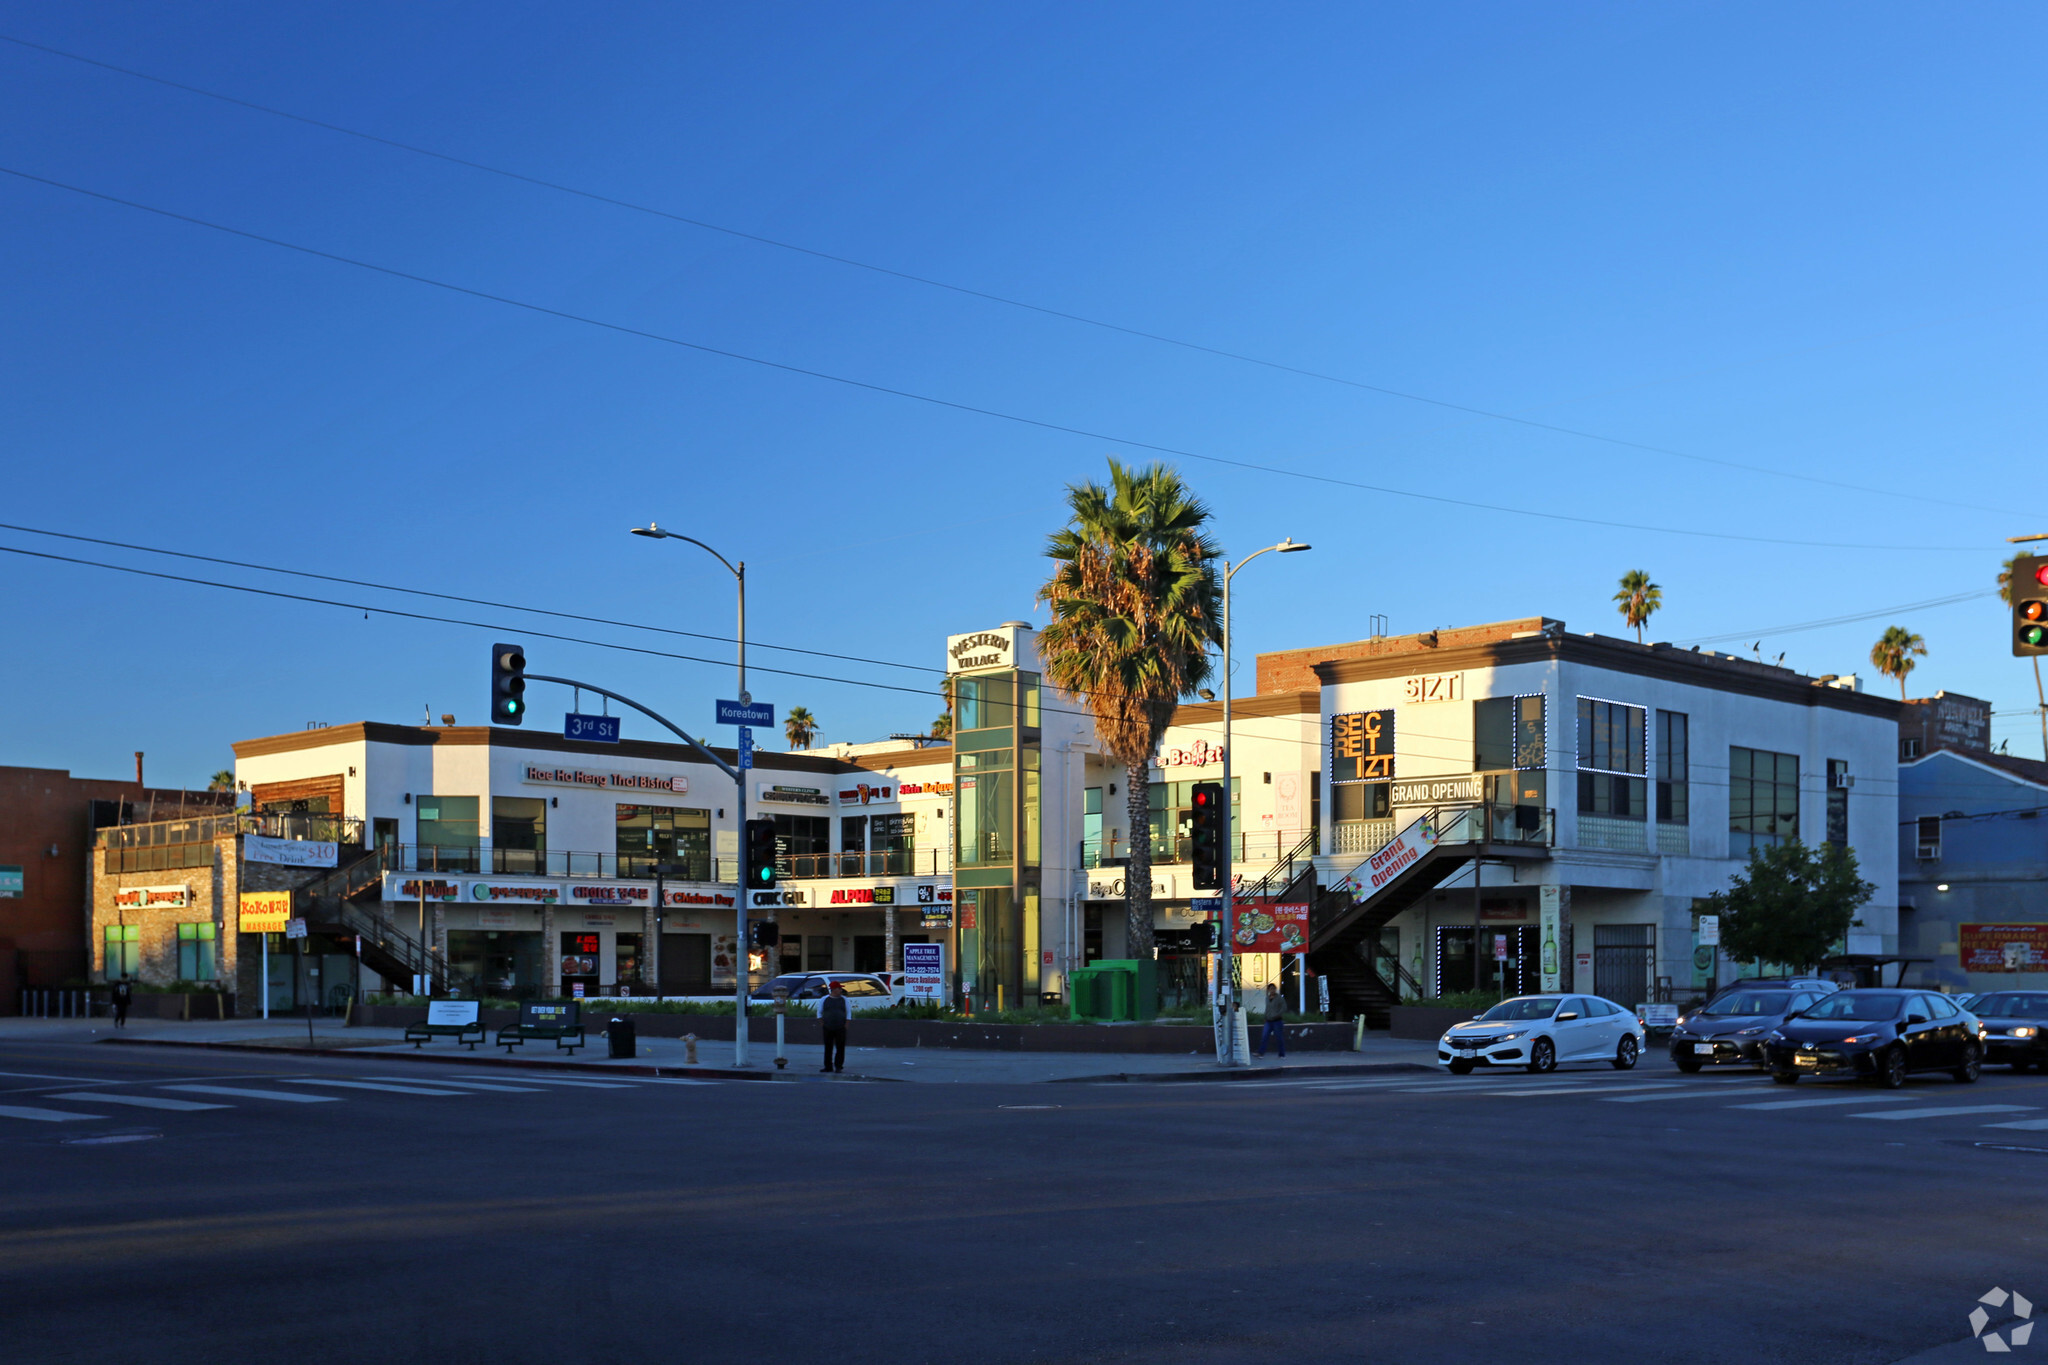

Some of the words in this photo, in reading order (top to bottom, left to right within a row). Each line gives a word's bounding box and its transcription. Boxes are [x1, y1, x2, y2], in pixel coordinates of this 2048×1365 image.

[949, 633, 1010, 659] WESTERN
[958, 653, 1001, 668] VILLAGE
[721, 707, 769, 721] Koreatown
[572, 718, 594, 735] 3rd
[599, 722, 613, 736] St
[1334, 711, 1382, 737] SEC
[1356, 754, 1394, 778] IZT
[528, 767, 553, 781] Hae
[575, 771, 608, 788] Heng
[611, 773, 637, 787] Thai
[639, 776, 672, 790] Bistro
[899, 783, 921, 795] Skin
[1392, 784, 1429, 802] GRAND
[1432, 781, 1482, 800] OPENING
[763, 792, 829, 805] CHIROPRACTIC
[280, 853, 306, 864] Drink
[308, 844, 335, 860] $10
[1370, 838, 1406, 871] Grand
[1371, 846, 1418, 888] Opening
[573, 886, 615, 899] CHOICE
[674, 892, 714, 905] Chicken
[715, 894, 736, 907] Day
[830, 888, 874, 904] ALPHA
[246, 922, 282, 931] MASSAGE
[906, 976, 919, 984] Space
[920, 976, 940, 984] Available
